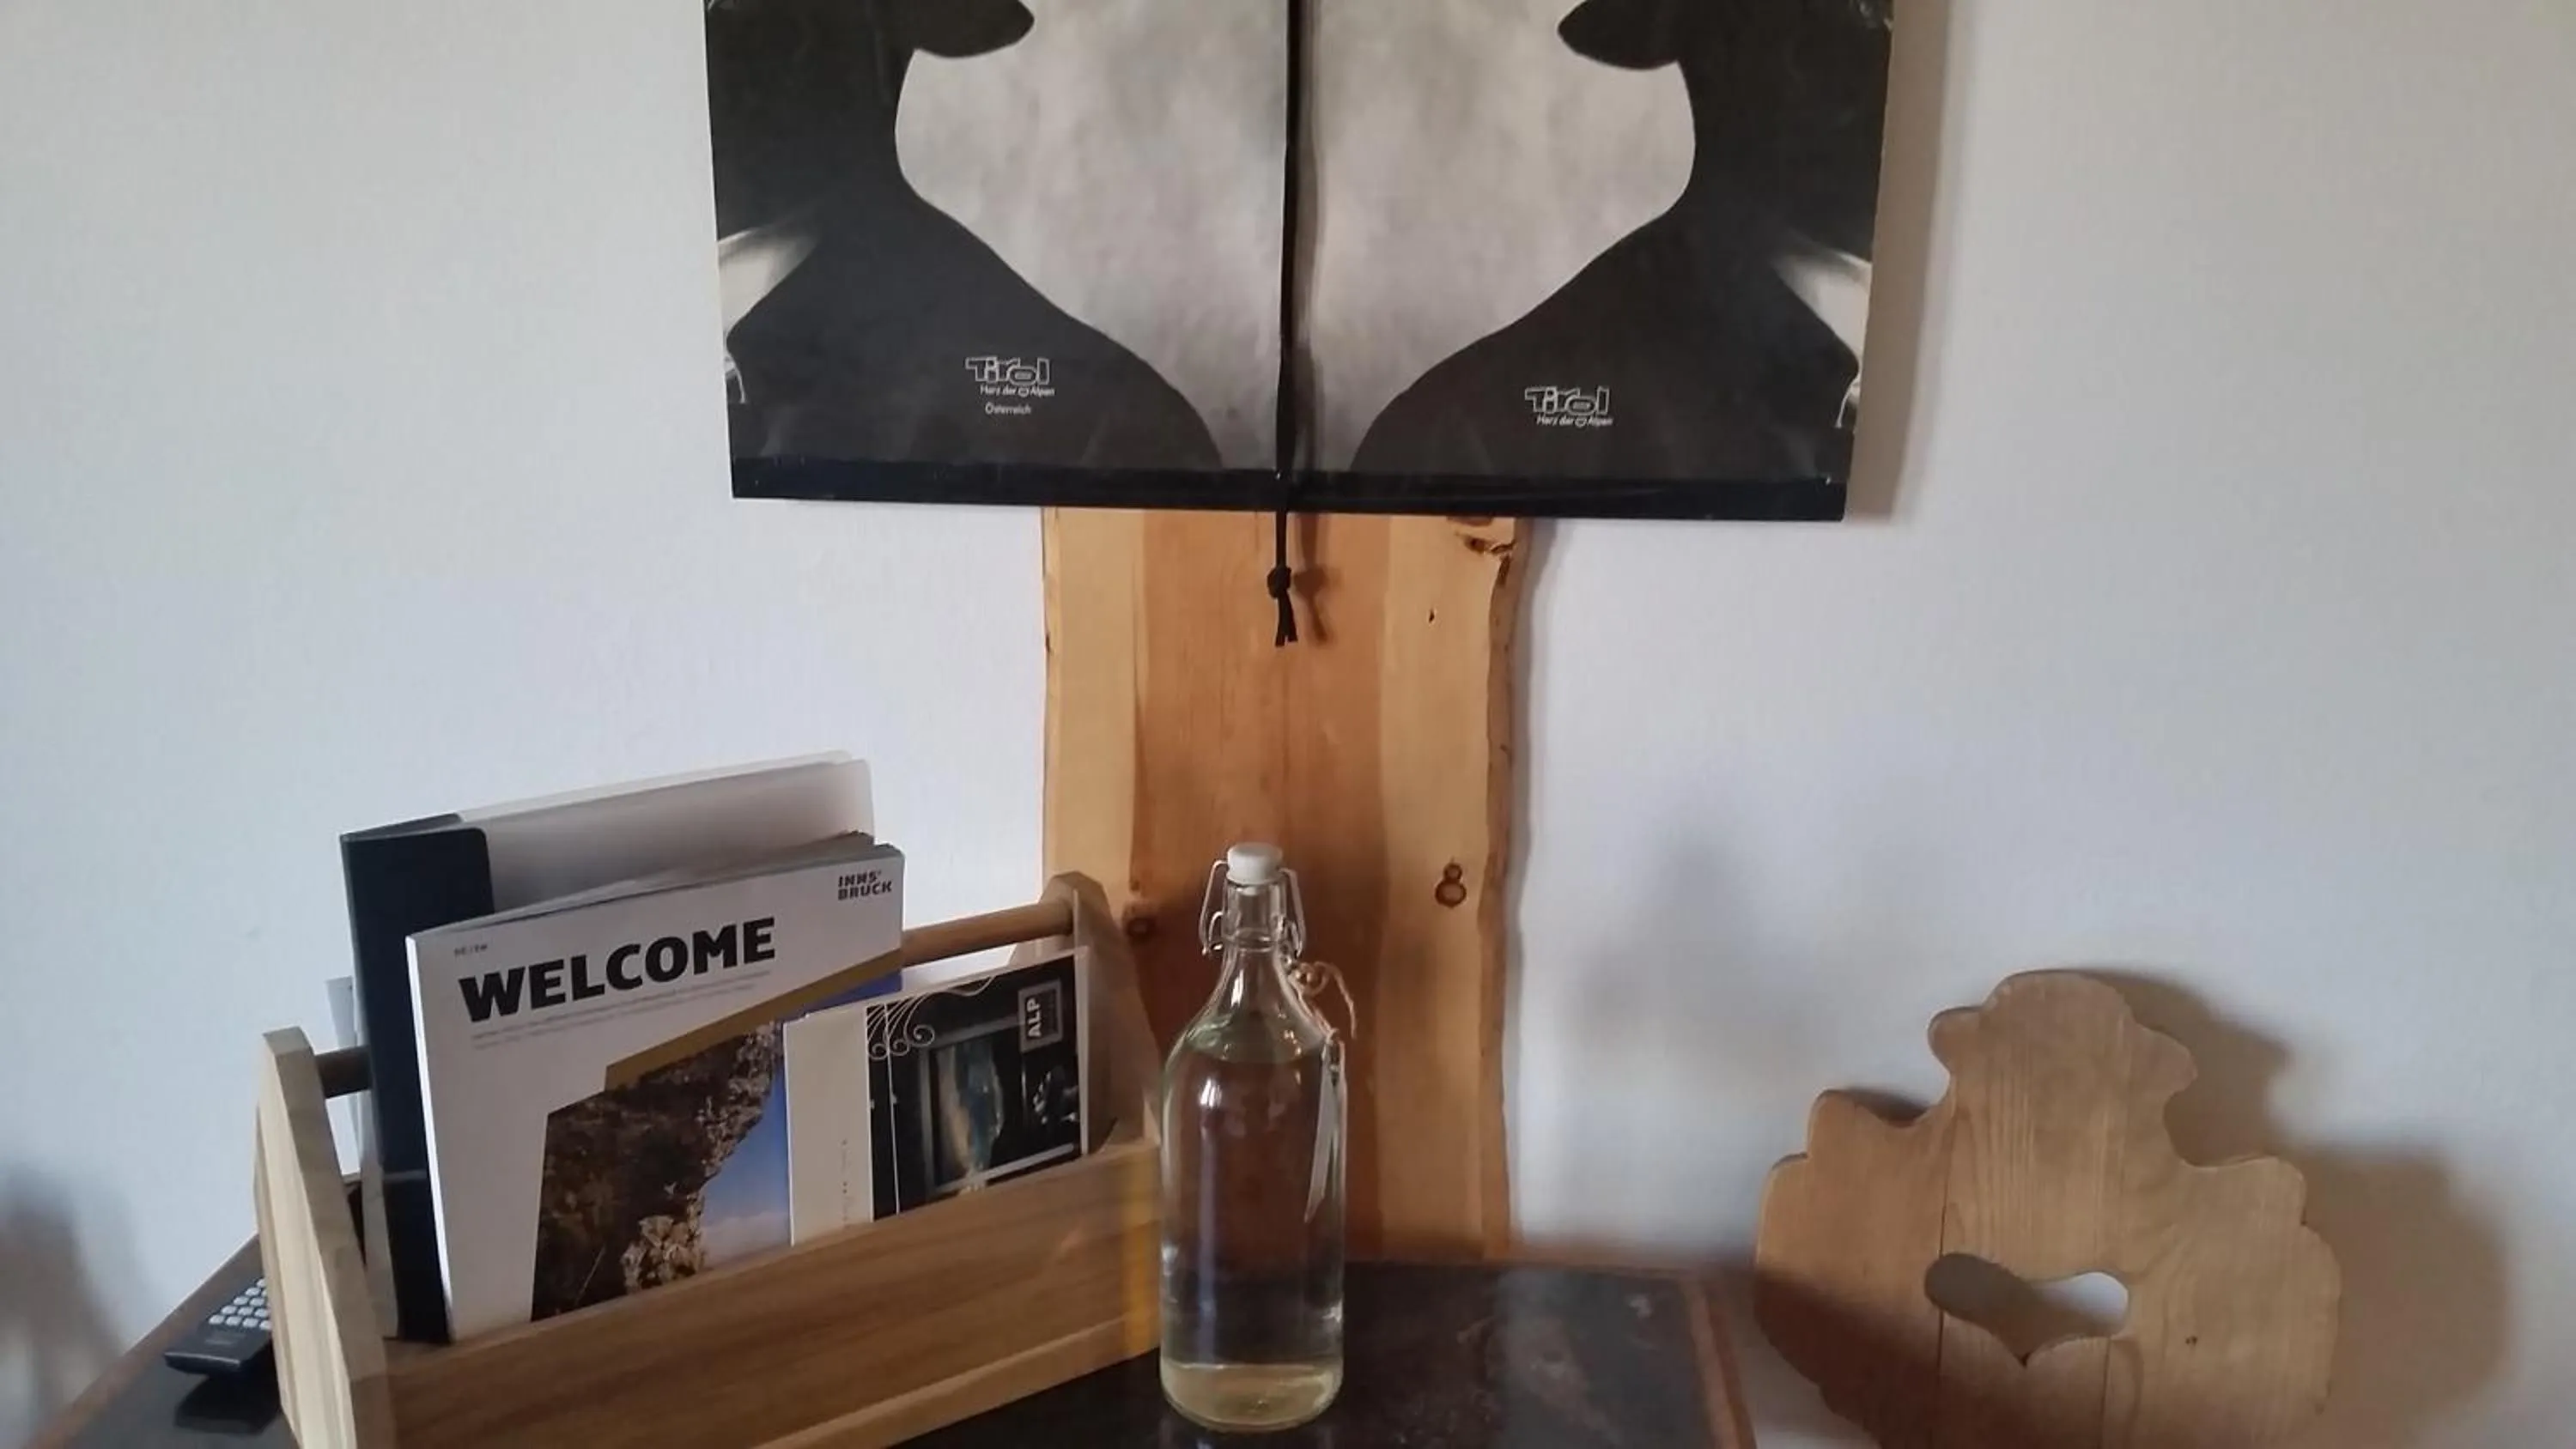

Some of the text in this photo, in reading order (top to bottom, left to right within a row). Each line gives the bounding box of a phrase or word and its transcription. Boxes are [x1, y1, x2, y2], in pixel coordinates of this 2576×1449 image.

[965, 355, 1050, 386] Tirol
[1524, 385, 1610, 416] Tirol
[838, 880, 893, 900] BRUCK
[459, 918, 775, 1022] WELCOME
[1026, 997, 1042, 1037] ALP
